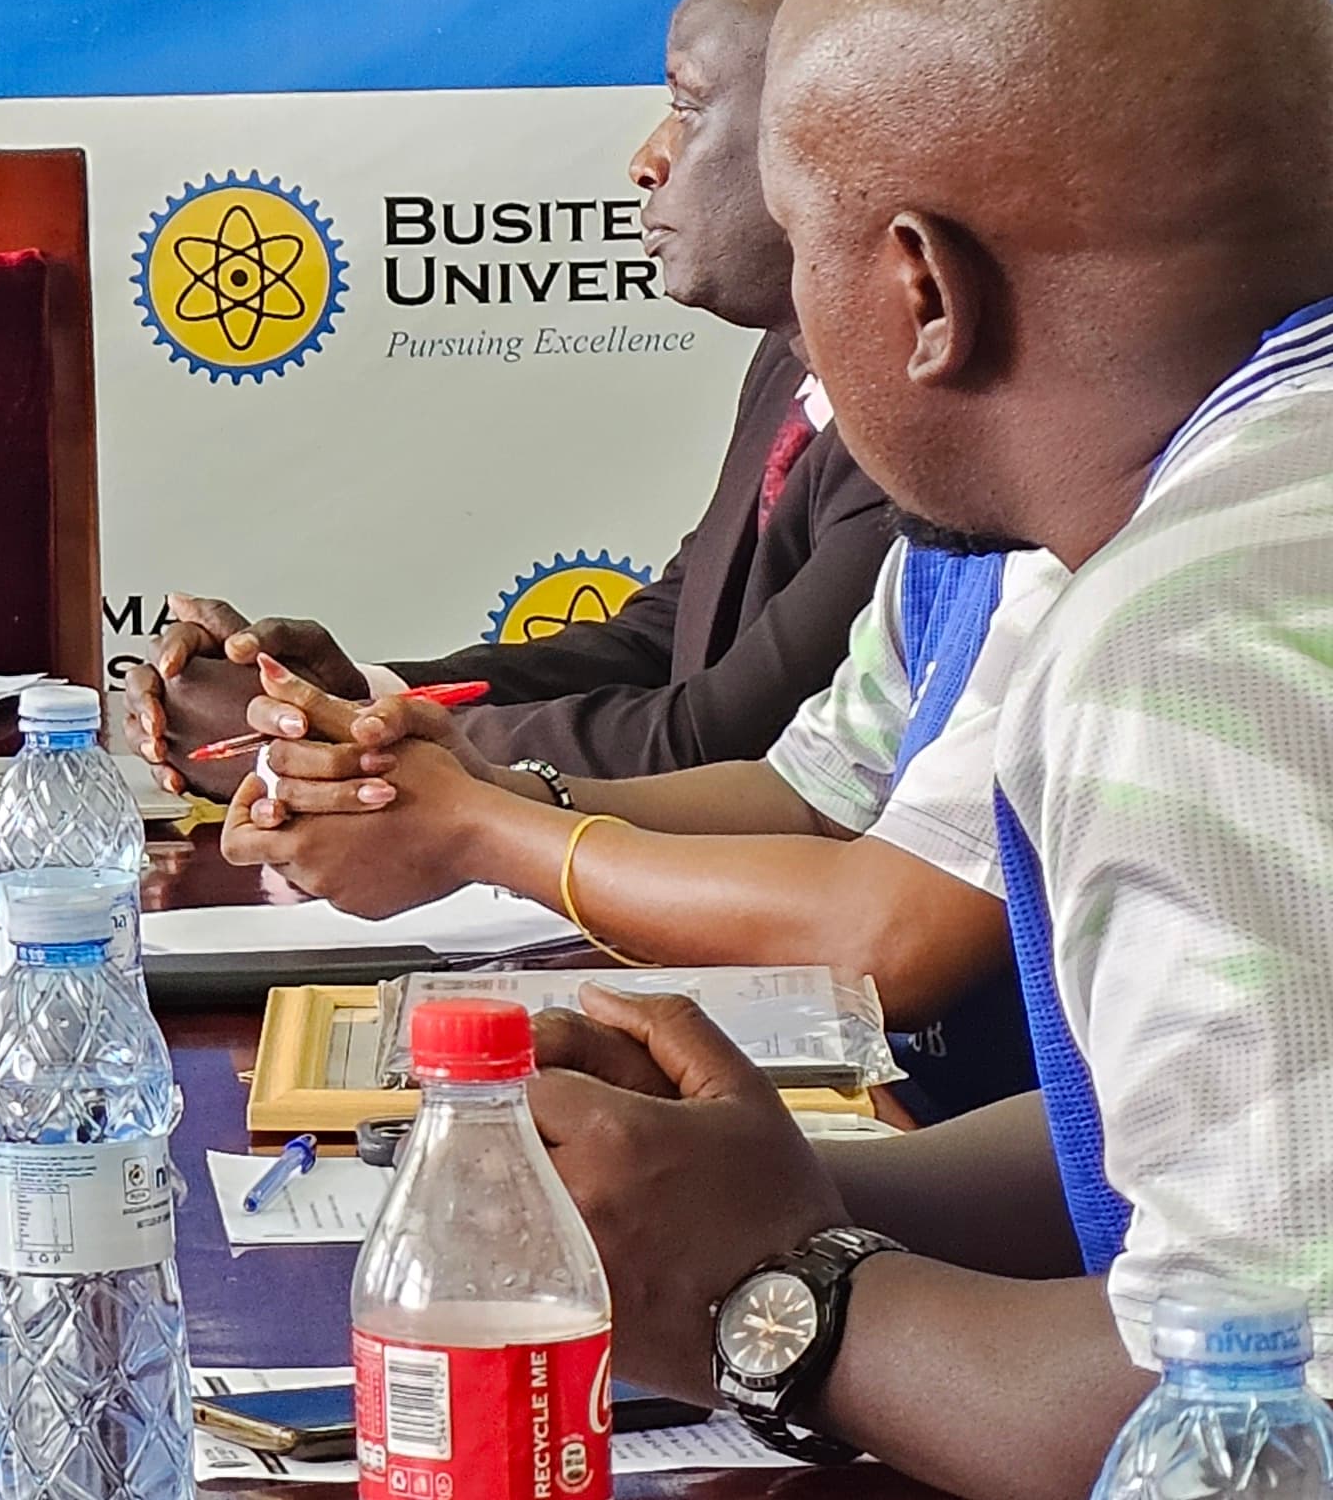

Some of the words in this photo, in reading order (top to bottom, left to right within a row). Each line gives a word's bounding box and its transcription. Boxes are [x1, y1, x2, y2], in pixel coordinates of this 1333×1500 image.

[384, 196, 642, 245] BUSITE
[384, 255, 661, 306] UNIVER
[385, 330, 524, 363] Pursuing
[533, 325, 695, 354] Excellence
[529, 1350, 549, 1387] ME
[529, 1389, 552, 1499] RECYCLE
